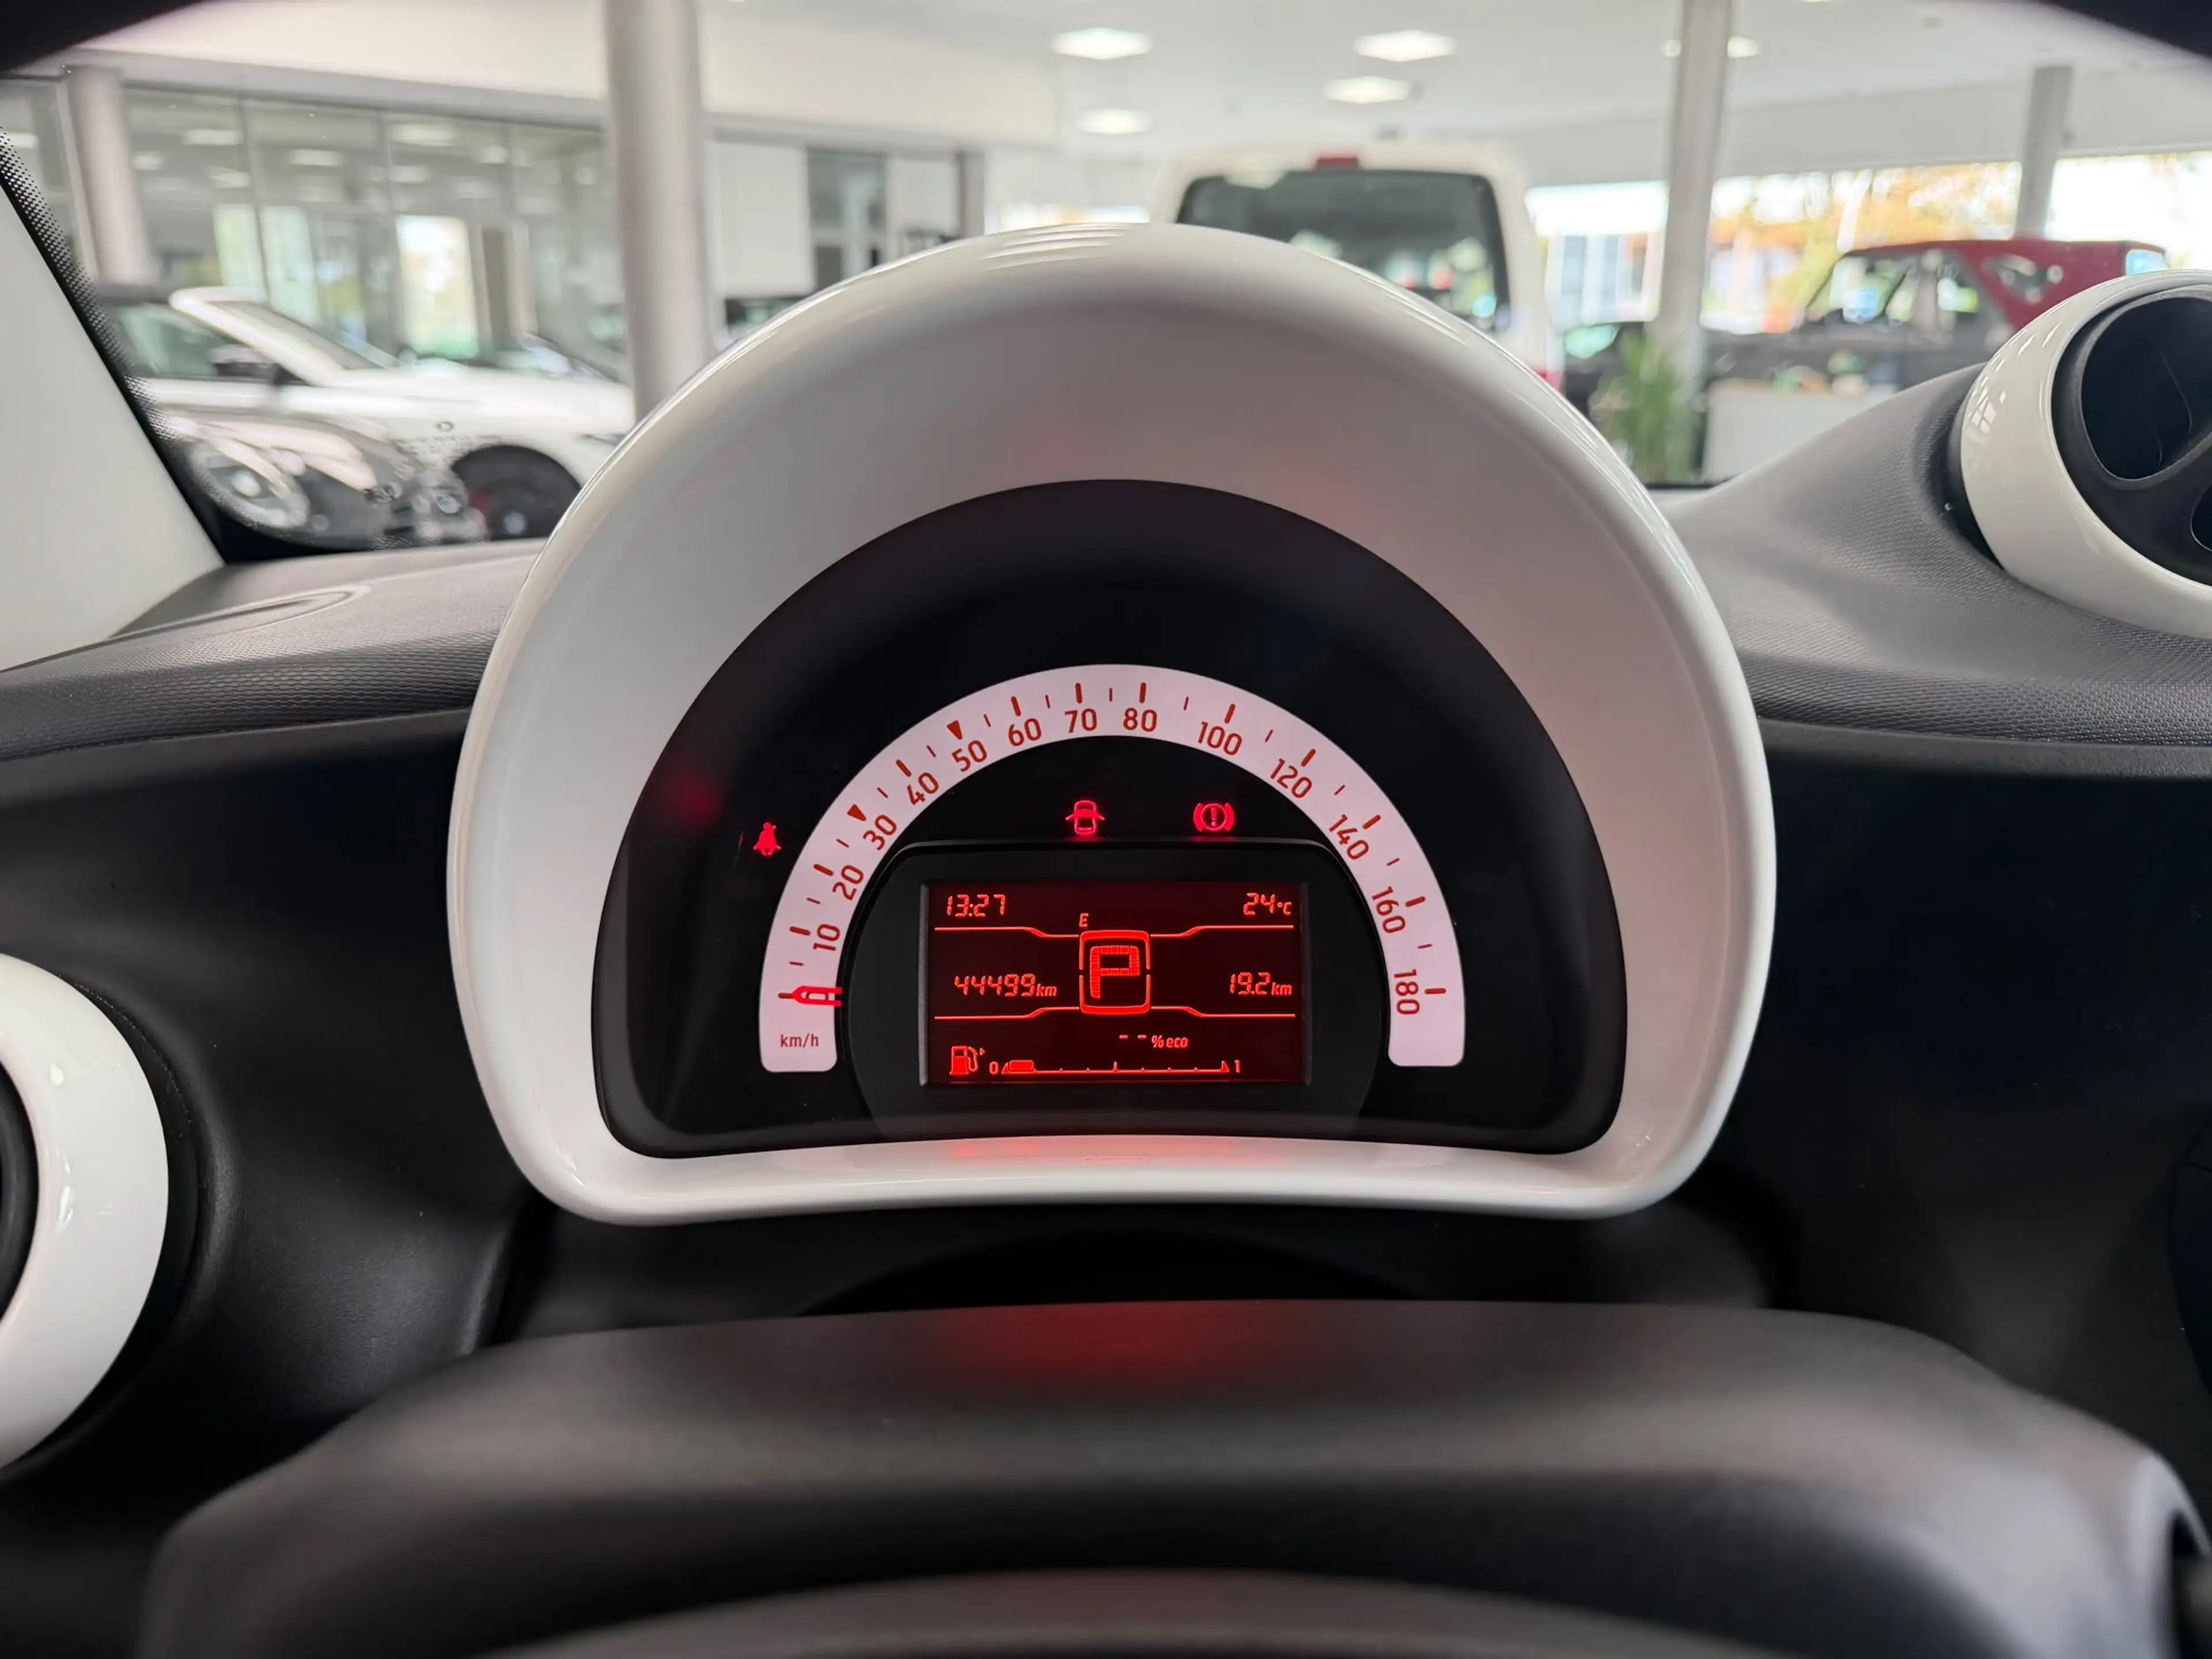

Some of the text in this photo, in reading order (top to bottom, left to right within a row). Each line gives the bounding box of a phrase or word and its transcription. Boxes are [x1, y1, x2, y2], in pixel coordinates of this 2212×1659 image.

[1008, 718, 1042, 747] 60
[1065, 708, 1098, 733] 70
[1123, 707, 1158, 732] 80
[1198, 721, 1243, 756] 100
[951, 740, 988, 772] 50
[907, 772, 940, 805] 40
[1270, 758, 1312, 798] 120
[863, 815, 897, 851] 30
[1328, 814, 1369, 860] 140
[832, 865, 865, 901] 20
[946, 893, 1006, 918] 13:27
[1078, 912, 1089, 927] E
[1371, 886, 1406, 934] 160
[813, 923, 841, 952] 10
[1089, 945, 1141, 999] P
[1393, 969, 1421, 1016] 180
[780, 1034, 819, 1048] km/h
